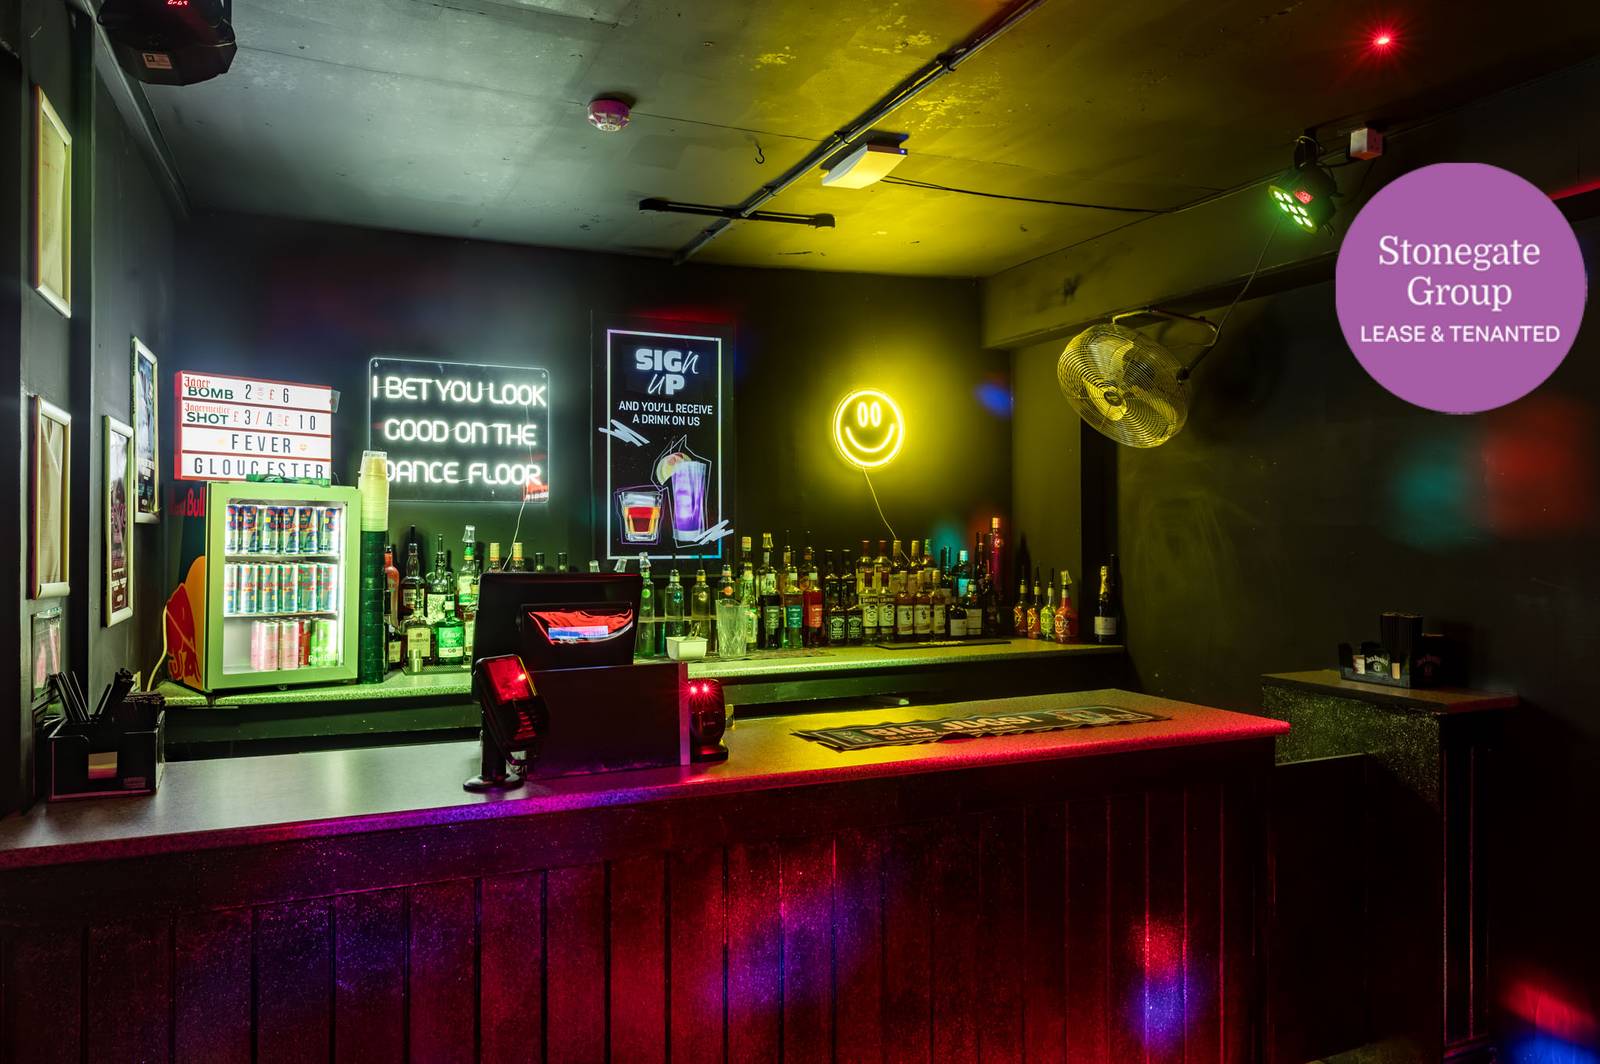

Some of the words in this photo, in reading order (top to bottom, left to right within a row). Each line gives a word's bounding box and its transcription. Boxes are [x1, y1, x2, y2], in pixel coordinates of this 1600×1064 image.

[188, 387, 234, 400] BOMB
[245, 384, 252, 400] 2
[372, 375, 378, 399] I
[385, 376, 433, 401] BET
[435, 378, 483, 403] YOU
[488, 382, 547, 407] LOOK
[186, 411, 229, 425] SHOT
[618, 401, 640, 411] AND
[642, 402, 674, 413] YOU'LL
[675, 403, 713, 415] RECEIVE
[632, 414, 640, 424] A
[641, 414, 669, 425] DRINK
[672, 415, 685, 425] ON
[687, 416, 700, 426] US
[384, 418, 449, 443] GOOD
[492, 422, 538, 446] THE
[231, 433, 291, 453] FEVER
[194, 457, 324, 479] GLOUCESTER
[387, 459, 460, 484] DANCE
[468, 462, 542, 486] FLOOR
[187, 487, 206, 518] Bull
